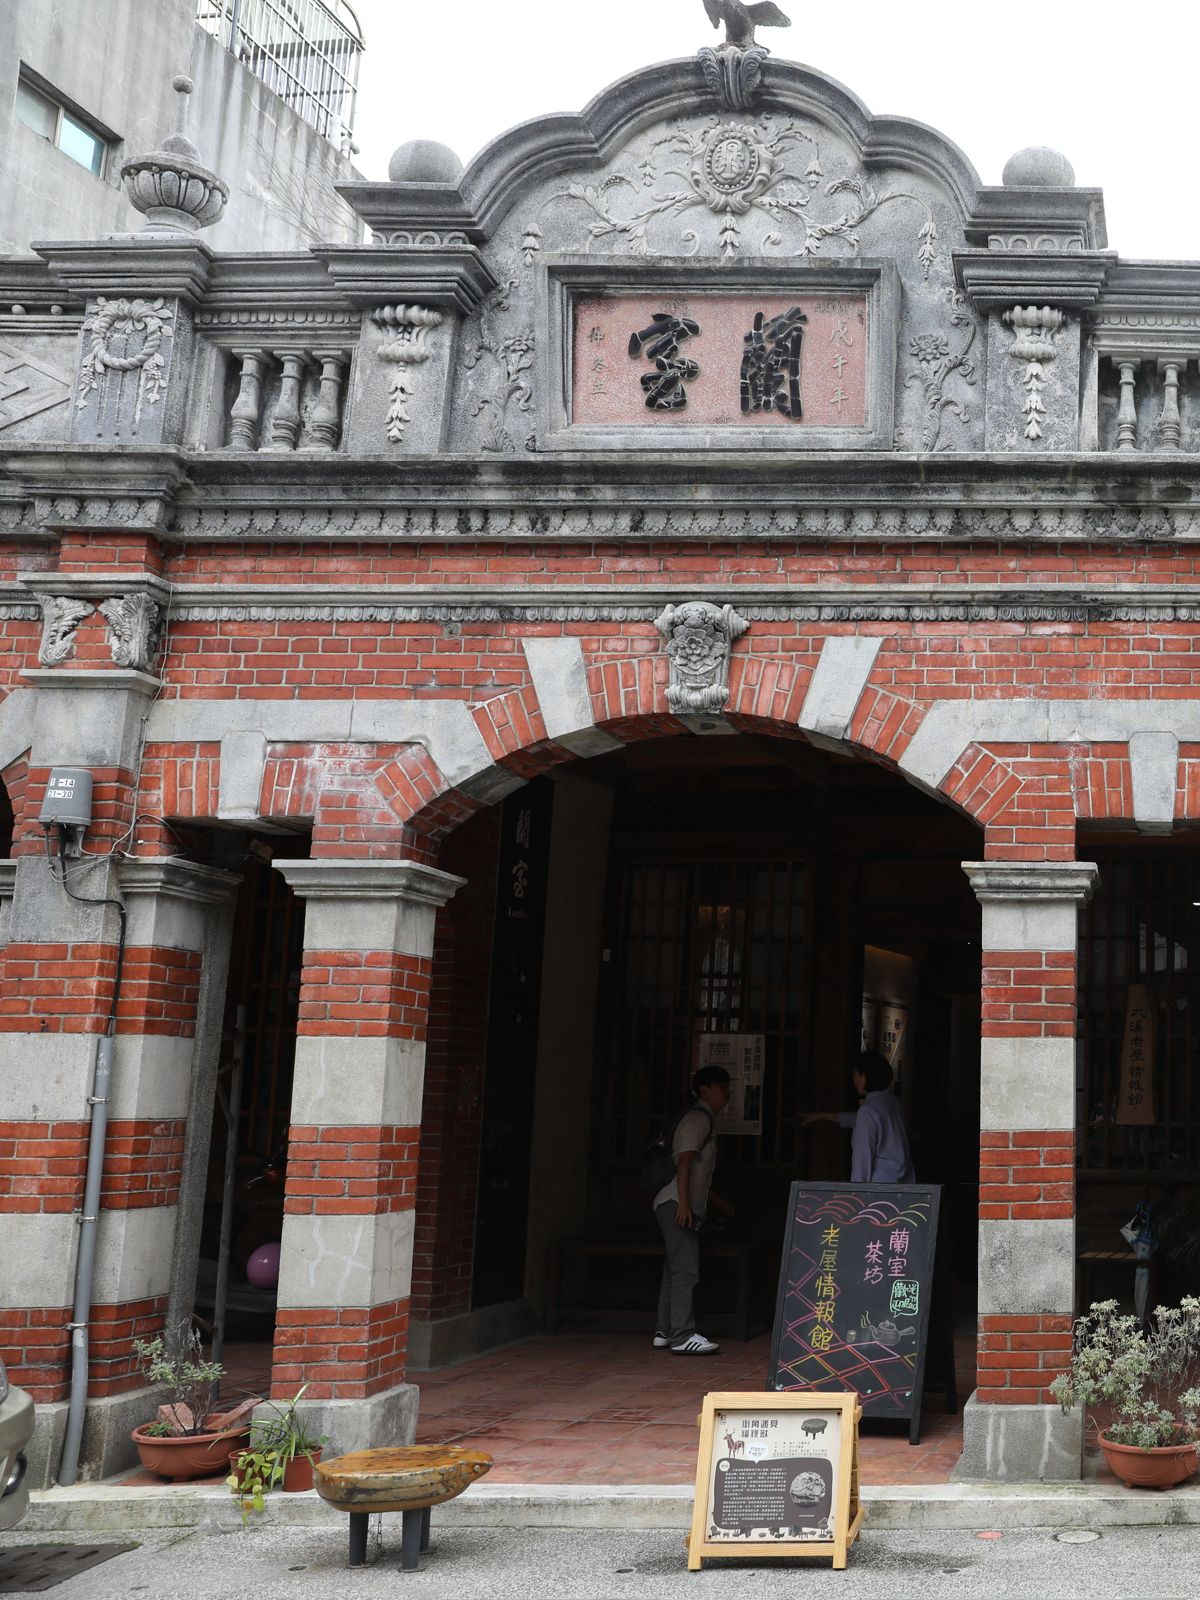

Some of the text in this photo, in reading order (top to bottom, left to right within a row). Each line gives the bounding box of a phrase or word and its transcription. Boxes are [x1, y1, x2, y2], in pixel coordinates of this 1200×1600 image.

[864, 1239, 884, 1285] 茶坊
[888, 1227, 910, 1277] 蘭室
[808, 1223, 840, 1351] 老屋情報館
